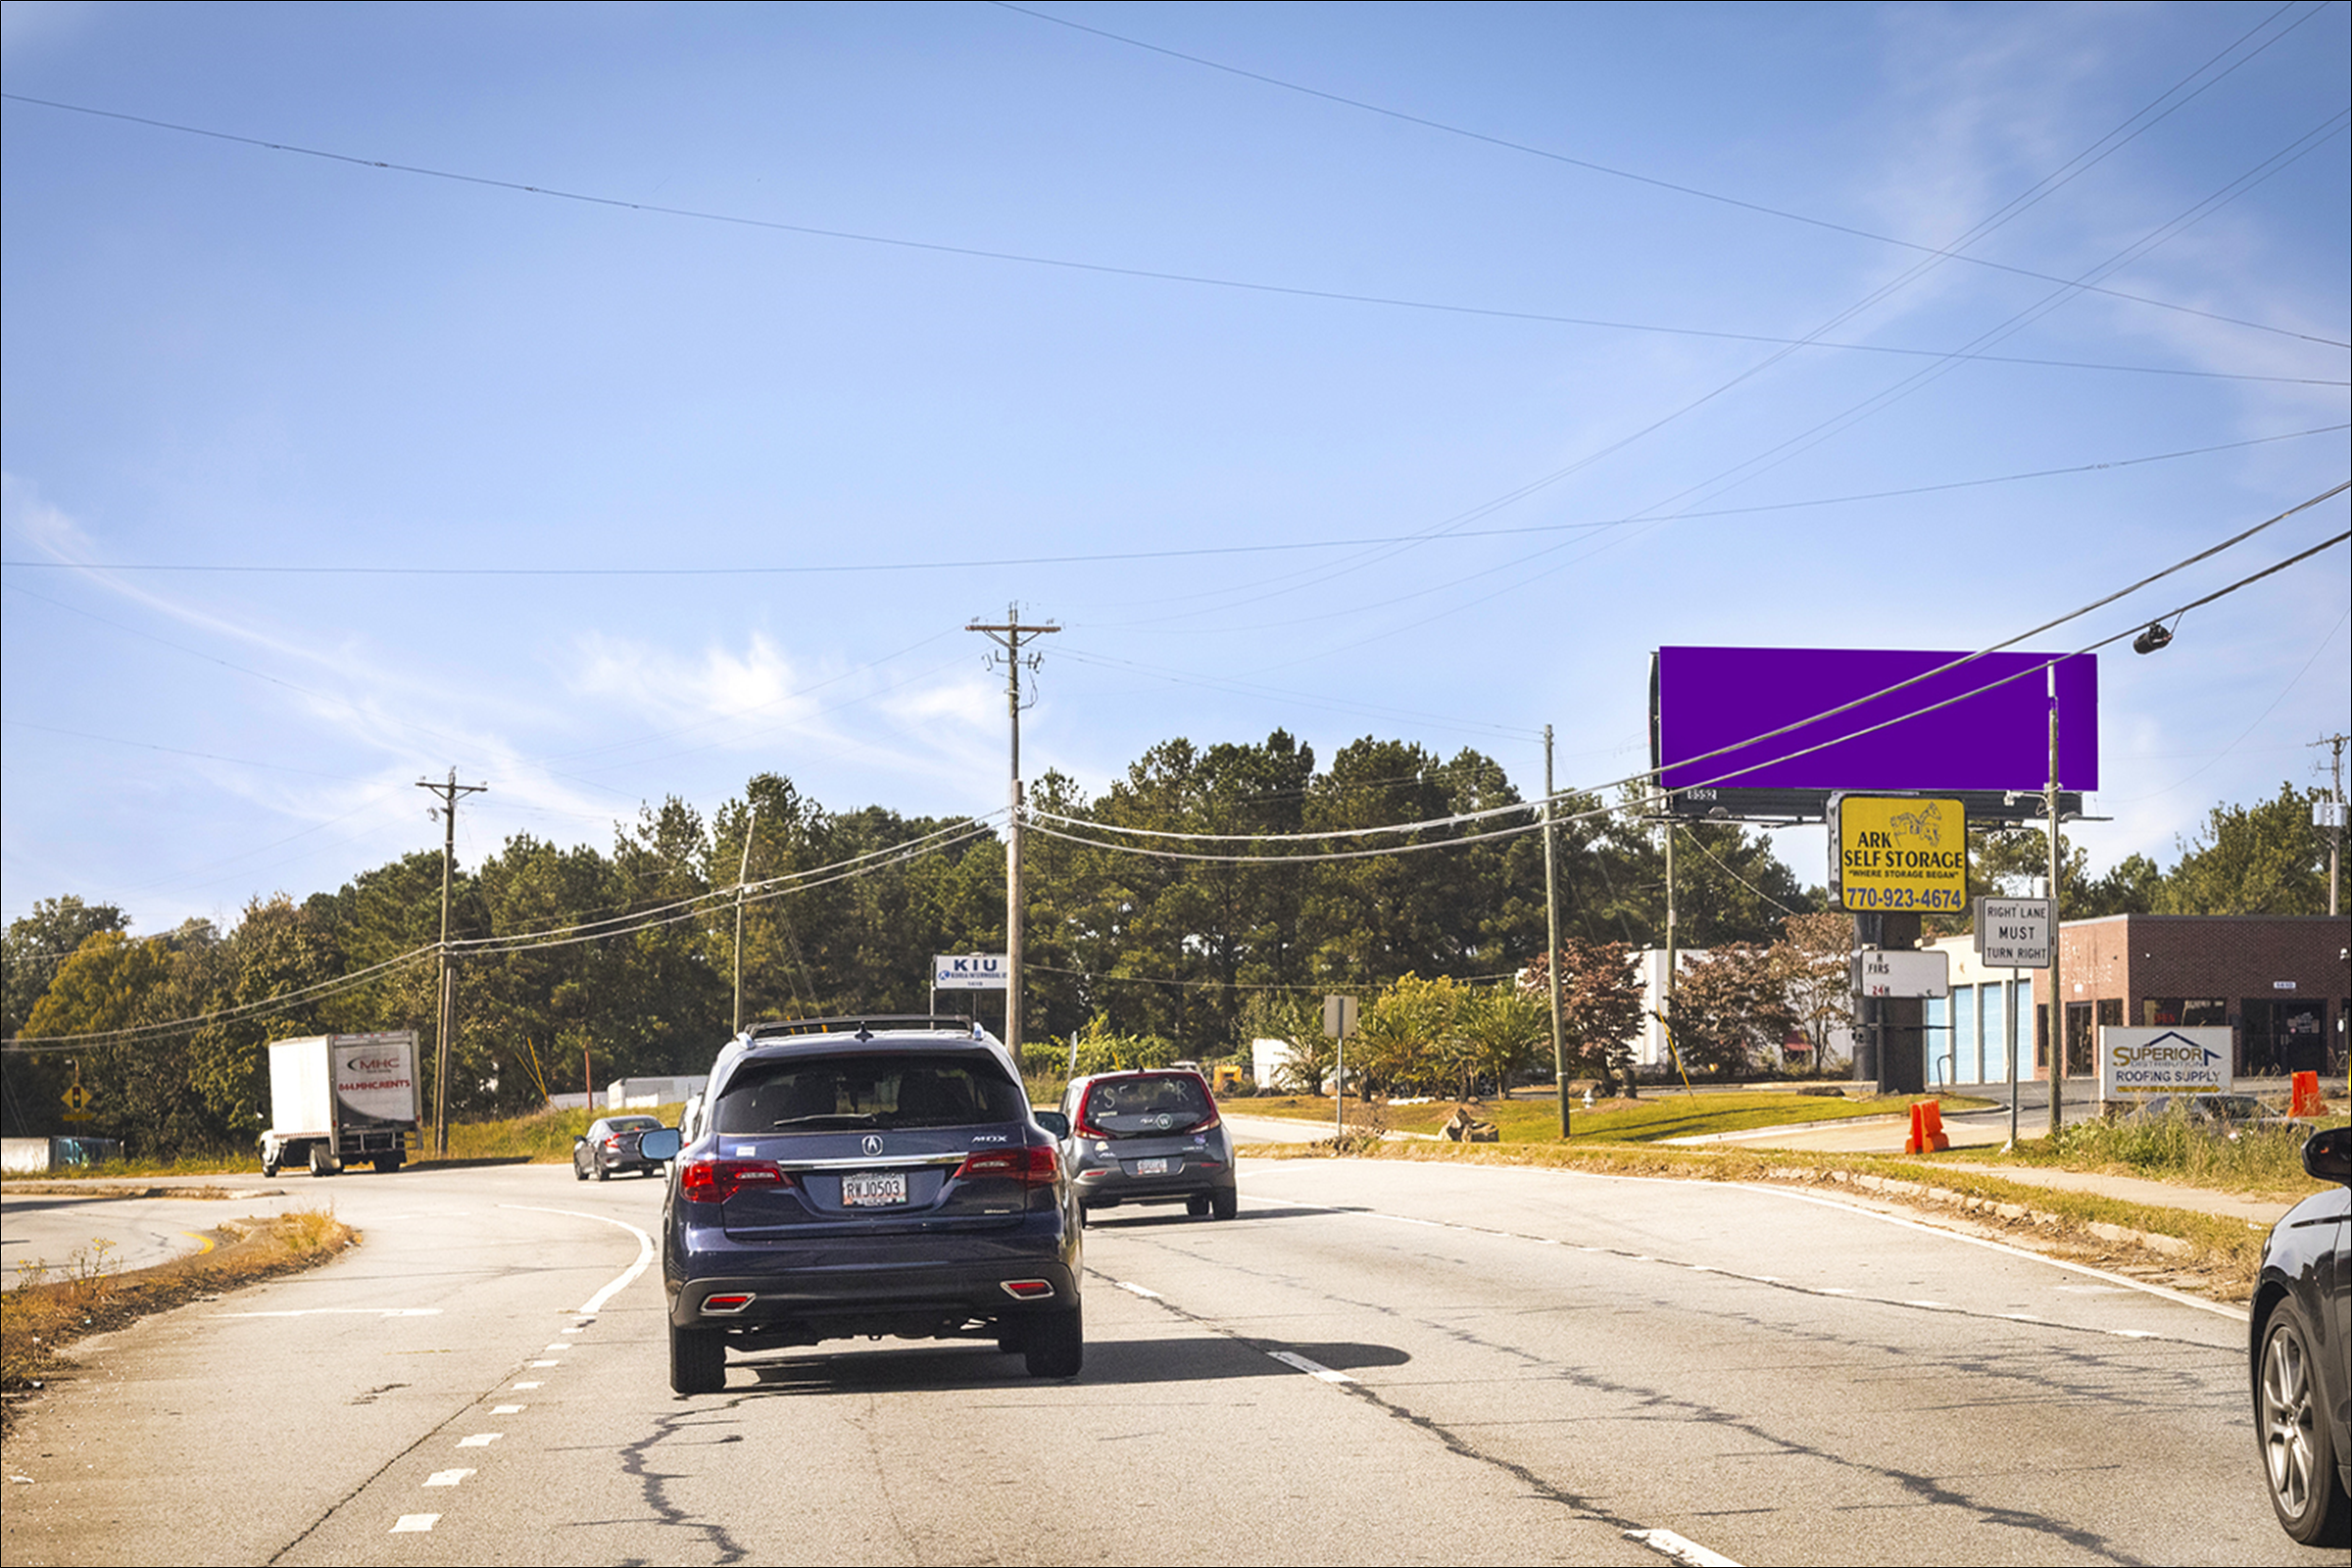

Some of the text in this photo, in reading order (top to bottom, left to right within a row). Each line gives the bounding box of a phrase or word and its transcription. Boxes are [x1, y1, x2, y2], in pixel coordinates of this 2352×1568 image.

[1857, 831, 1891, 848] ARK
[1844, 850, 1963, 868] SELF STORAGE
[1847, 887, 1962, 908] 770-923-4674
[1987, 906, 2046, 918] RIGHT LANE
[1999, 926, 2034, 940] MUST
[1986, 947, 2046, 959] TURN RIGHT
[954, 959, 998, 971] KIU
[2112, 1047, 2203, 1066] SUPERIOR
[360, 1058, 400, 1069] MHC
[2116, 1070, 2220, 1082] ROOFING SUPPLY
[971, 1135, 1007, 1144] MDX
